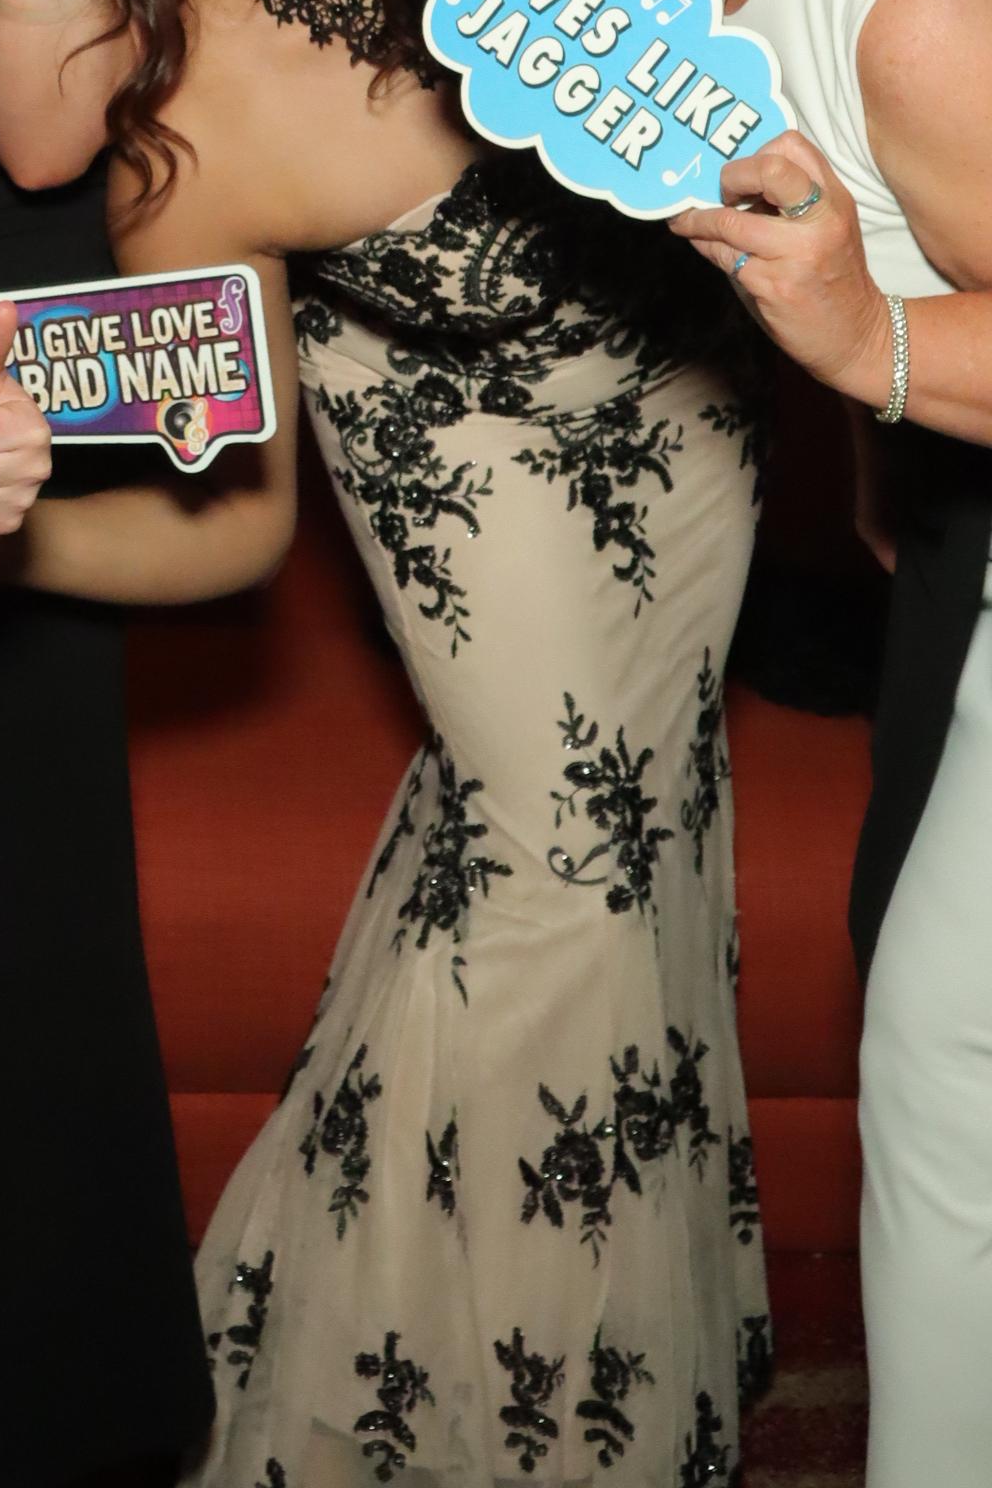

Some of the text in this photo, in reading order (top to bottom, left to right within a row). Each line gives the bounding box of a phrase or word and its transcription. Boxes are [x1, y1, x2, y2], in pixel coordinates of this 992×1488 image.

[625, 38, 761, 160] LIKE
[42, 315, 126, 359] GIVE
[132, 303, 219, 347] LOVE
[19, 341, 247, 413] BAD NAME
